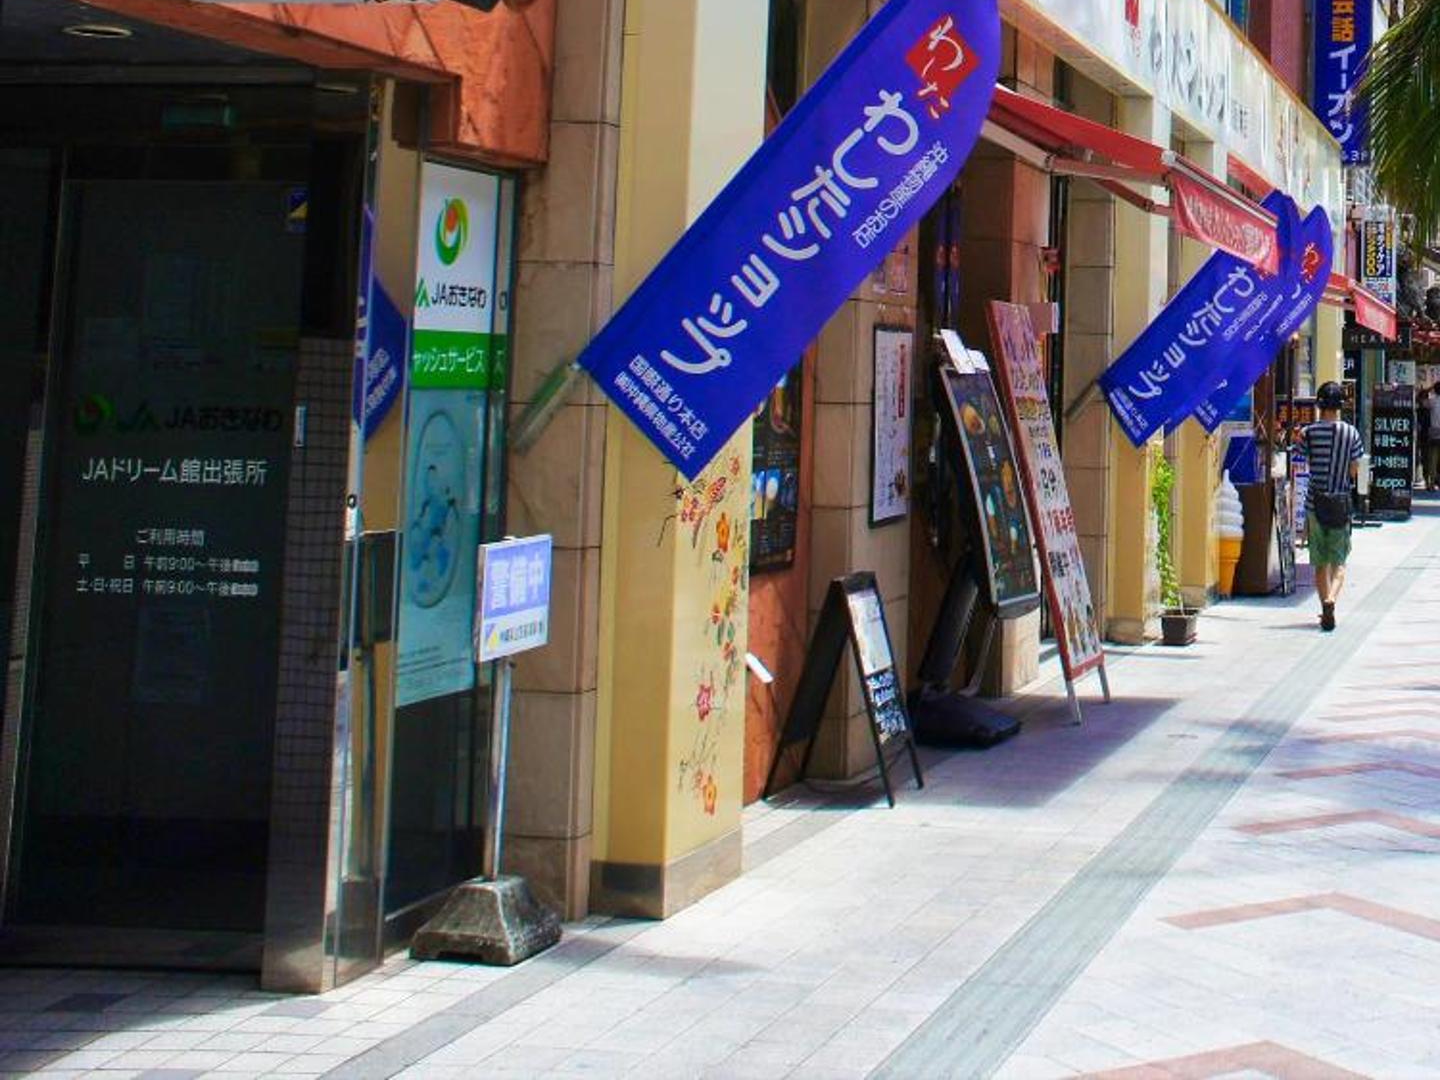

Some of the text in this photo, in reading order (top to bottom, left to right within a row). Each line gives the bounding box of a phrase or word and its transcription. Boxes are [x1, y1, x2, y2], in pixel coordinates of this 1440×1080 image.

[661, 87, 921, 377] わしたショップ
[431, 281, 487, 310] JAおきなわ
[1128, 265, 1256, 400] わしたショップ
[628, 354, 708, 441] 国際通り本店
[1375, 418, 1411, 432] SILVER
[82, 458, 268, 486] JAドリーム館出張所
[135, 528, 205, 547] ご利用時間
